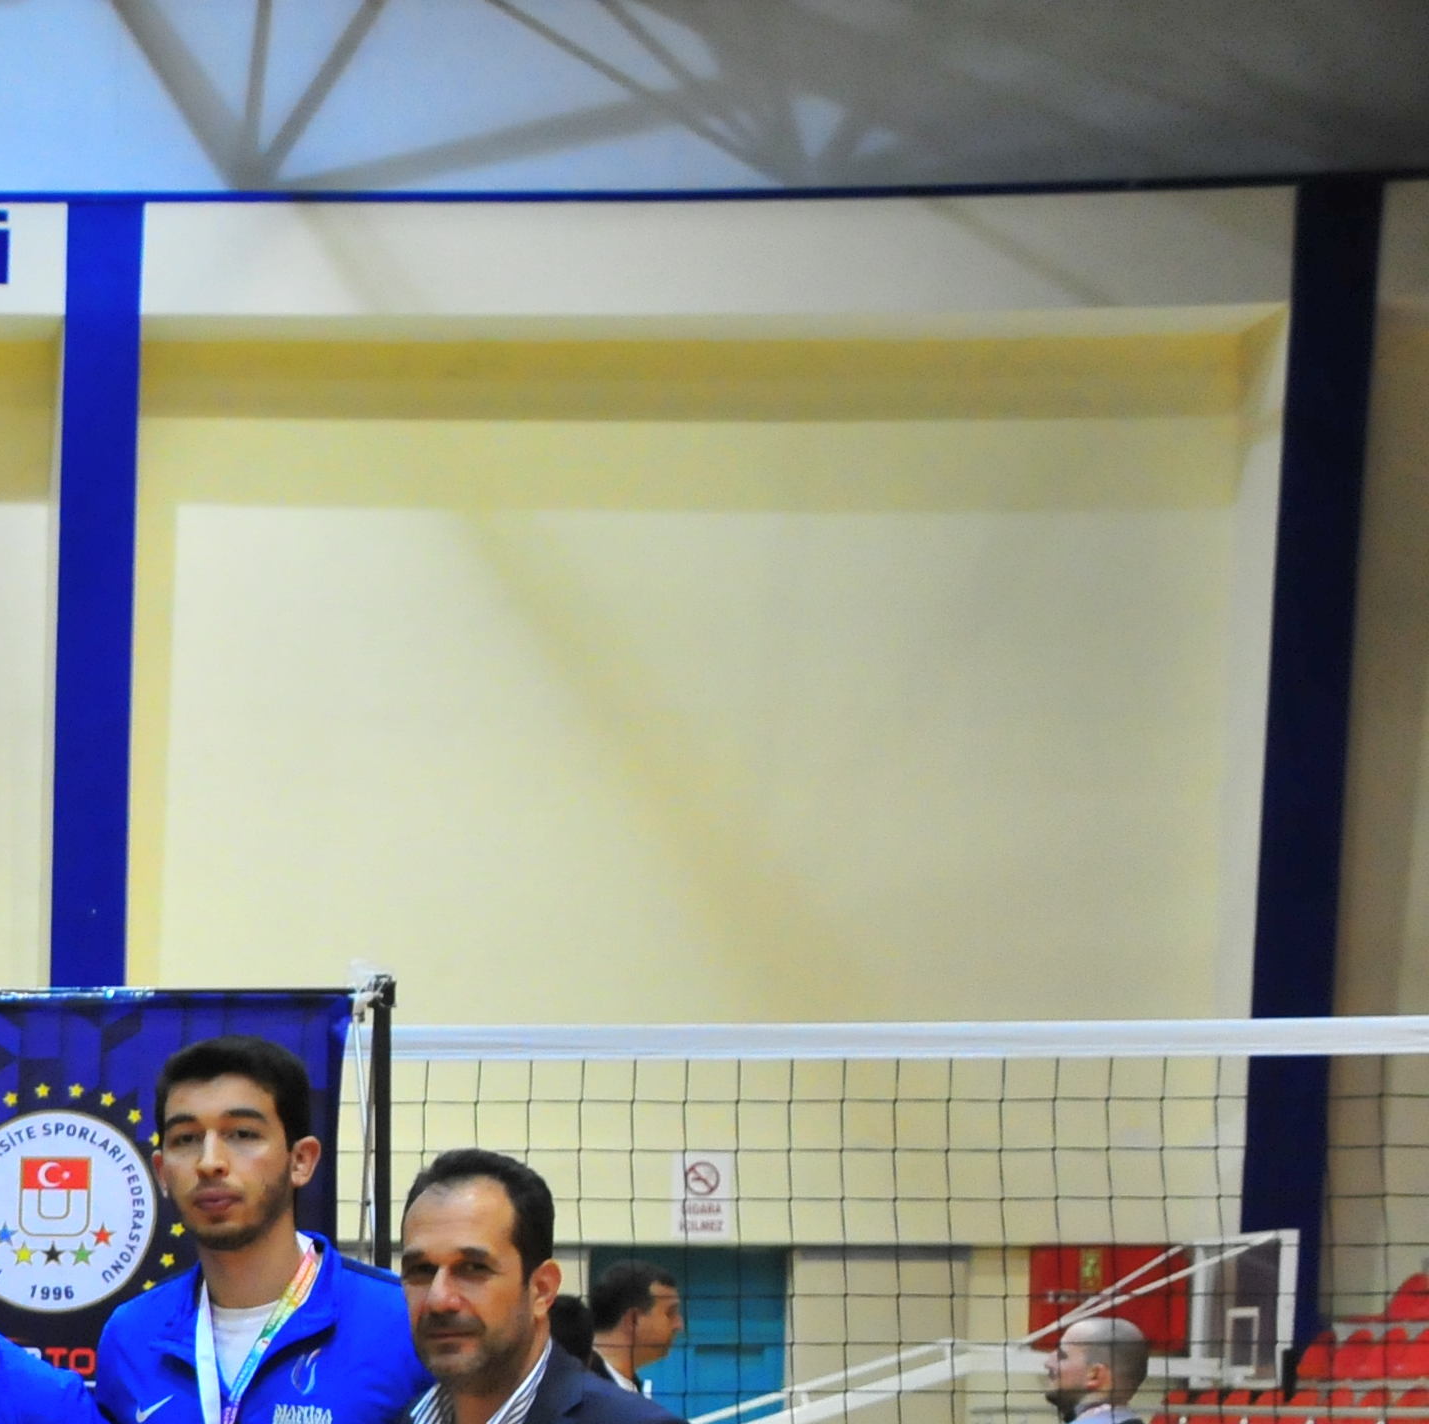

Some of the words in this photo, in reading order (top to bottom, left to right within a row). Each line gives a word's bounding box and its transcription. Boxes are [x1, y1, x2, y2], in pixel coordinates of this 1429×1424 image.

[42, 1122, 126, 1163] SPORLARI
[101, 1164, 146, 1283] FEDERASYONU
[29, 1284, 75, 1301] 1996
